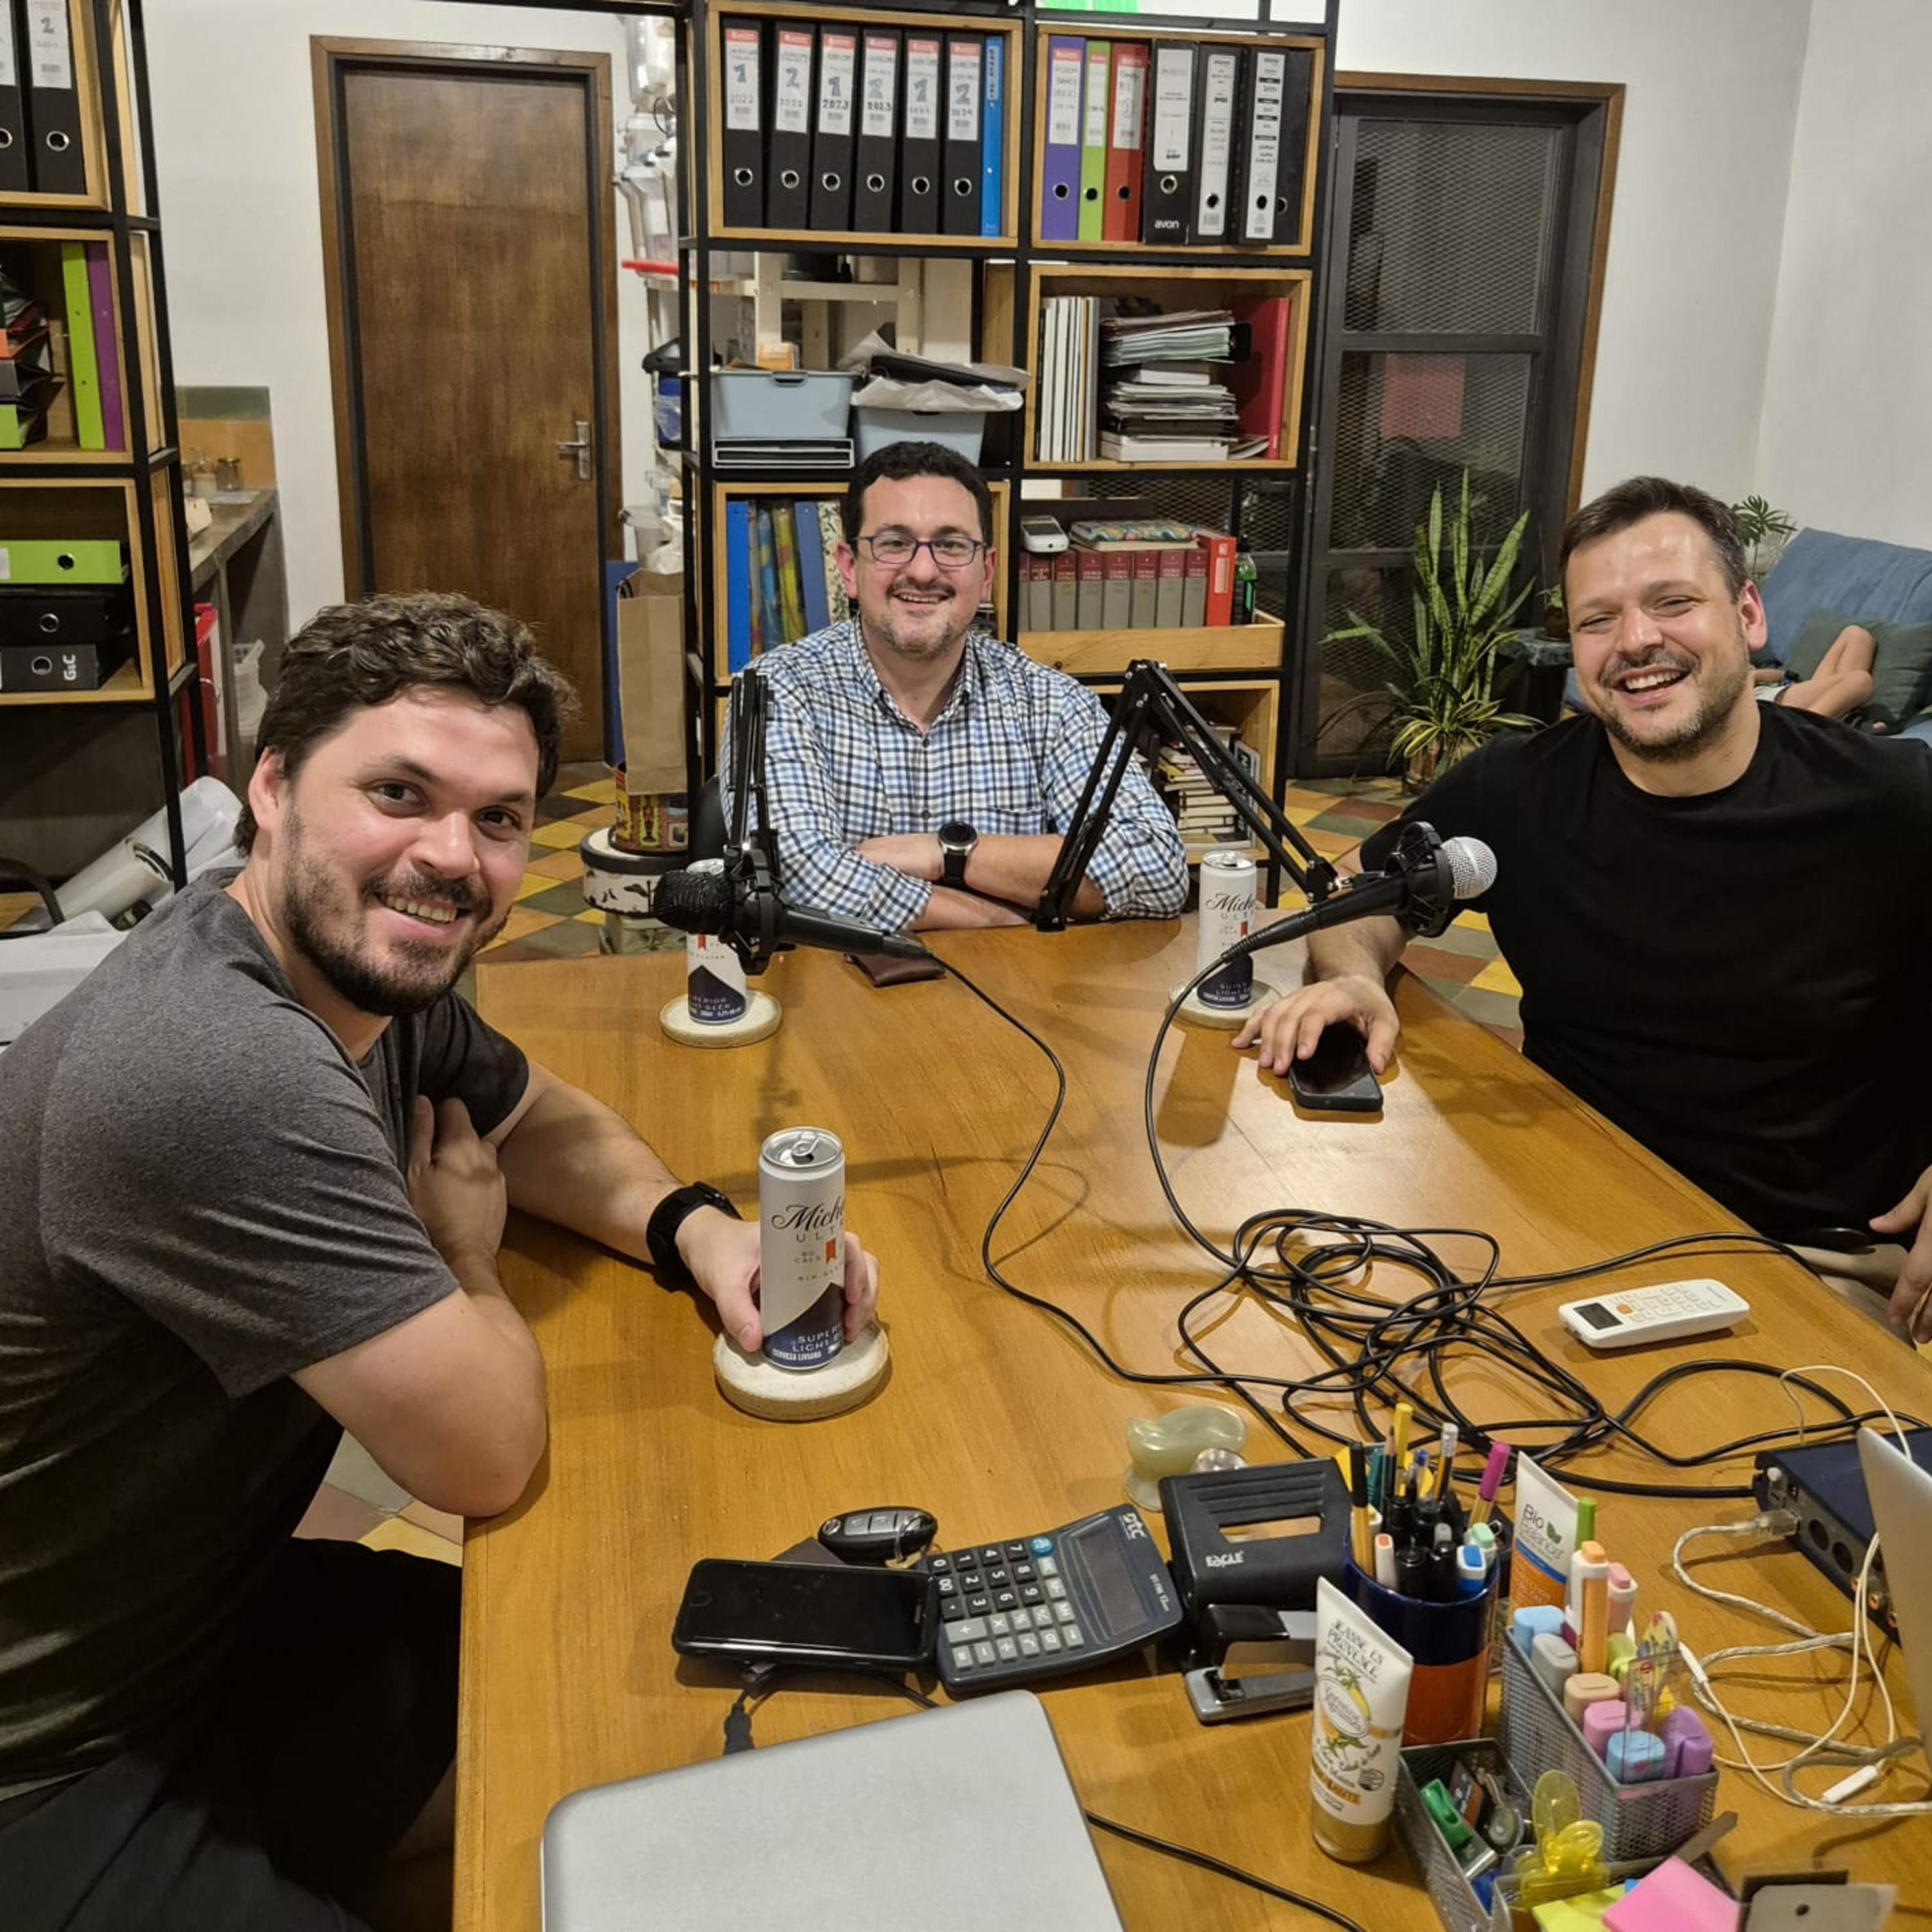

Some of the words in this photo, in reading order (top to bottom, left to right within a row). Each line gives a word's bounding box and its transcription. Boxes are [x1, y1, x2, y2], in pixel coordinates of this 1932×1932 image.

[40, 17, 55, 34] 2
[955, 83, 971, 104] 2
[1155, 220, 1179, 229] avon
[1522, 1503, 1544, 1529] Bio
[933, 1558, 947, 1567] 0
[991, 1570, 1005, 1578] 5
[1018, 1565, 1030, 1574] 8
[938, 1578, 953, 1591] 00
[1025, 1587, 1038, 1596] 9
[972, 1598, 987, 1606] 3
[999, 1593, 1013, 1602] 6
